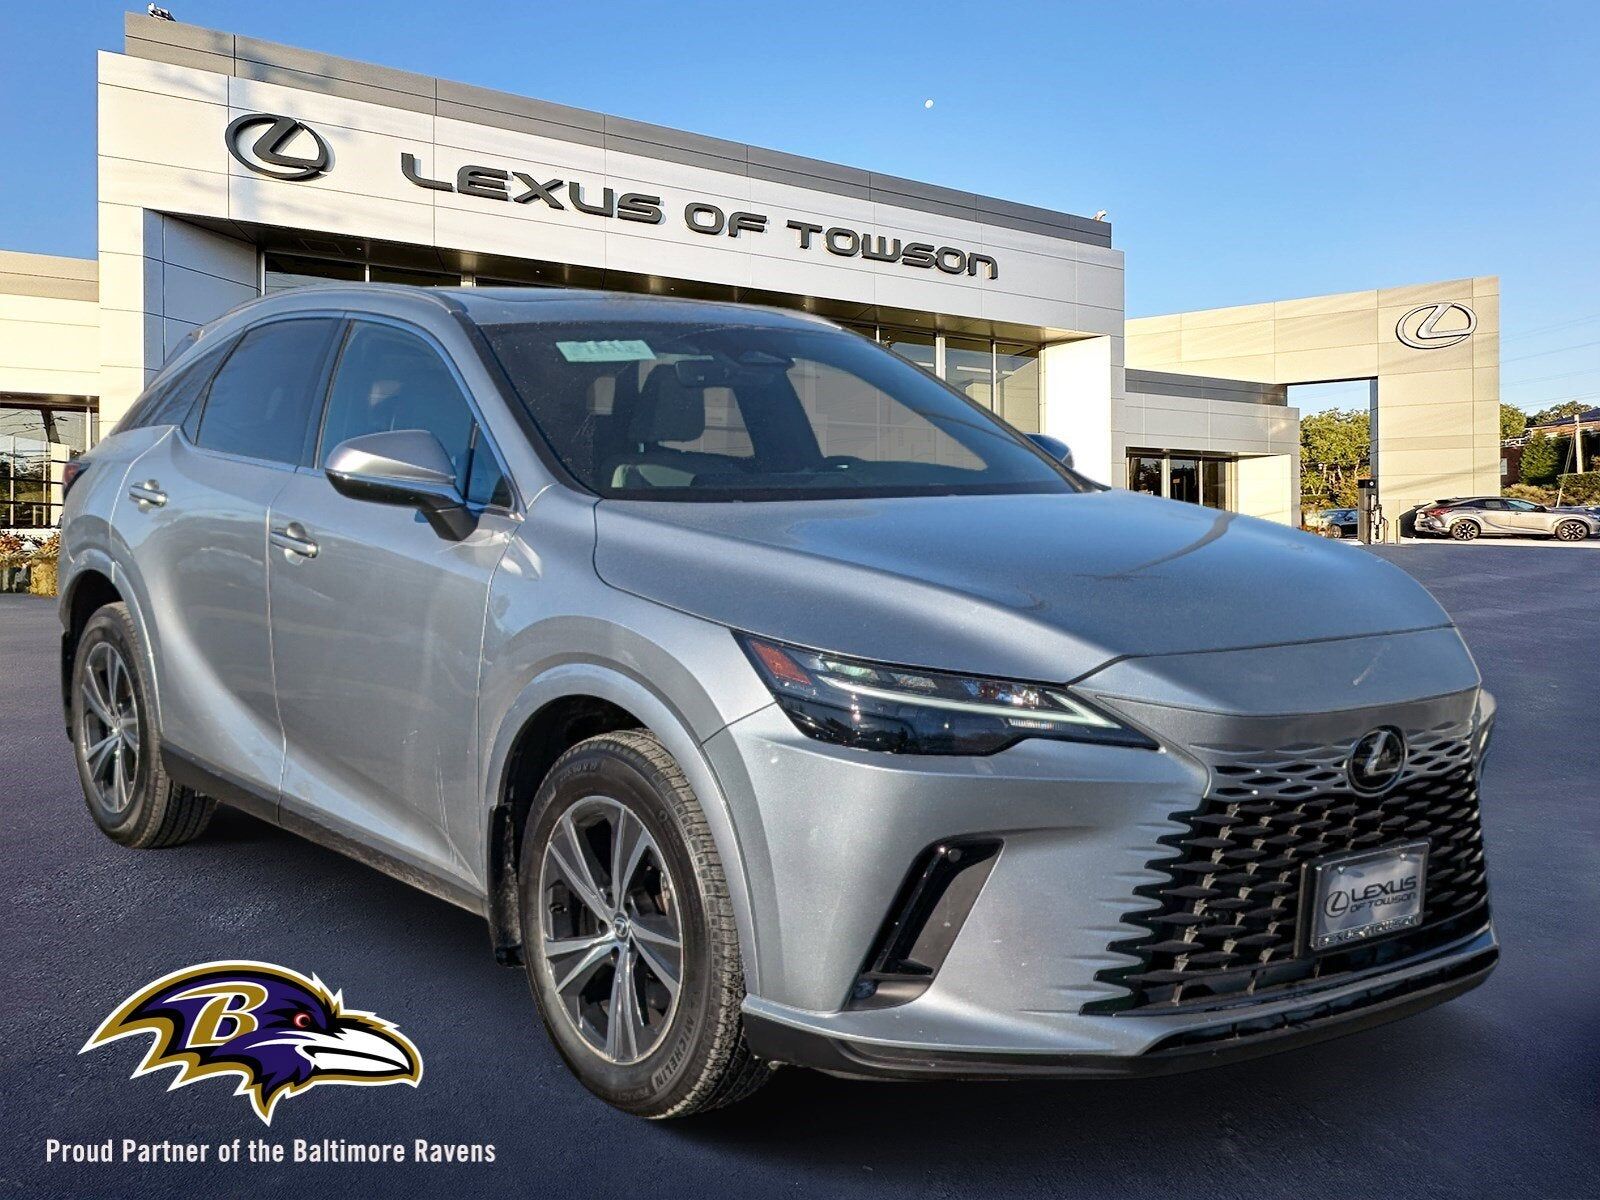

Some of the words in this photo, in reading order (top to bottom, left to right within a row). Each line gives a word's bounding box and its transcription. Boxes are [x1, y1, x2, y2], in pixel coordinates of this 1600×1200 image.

[400, 152, 664, 225] LEXUS
[684, 202, 768, 238] OF
[786, 219, 1000, 280] TOWSON
[1351, 875, 1417, 902] LEXUS
[655, 1014, 695, 1087] MICHELIN
